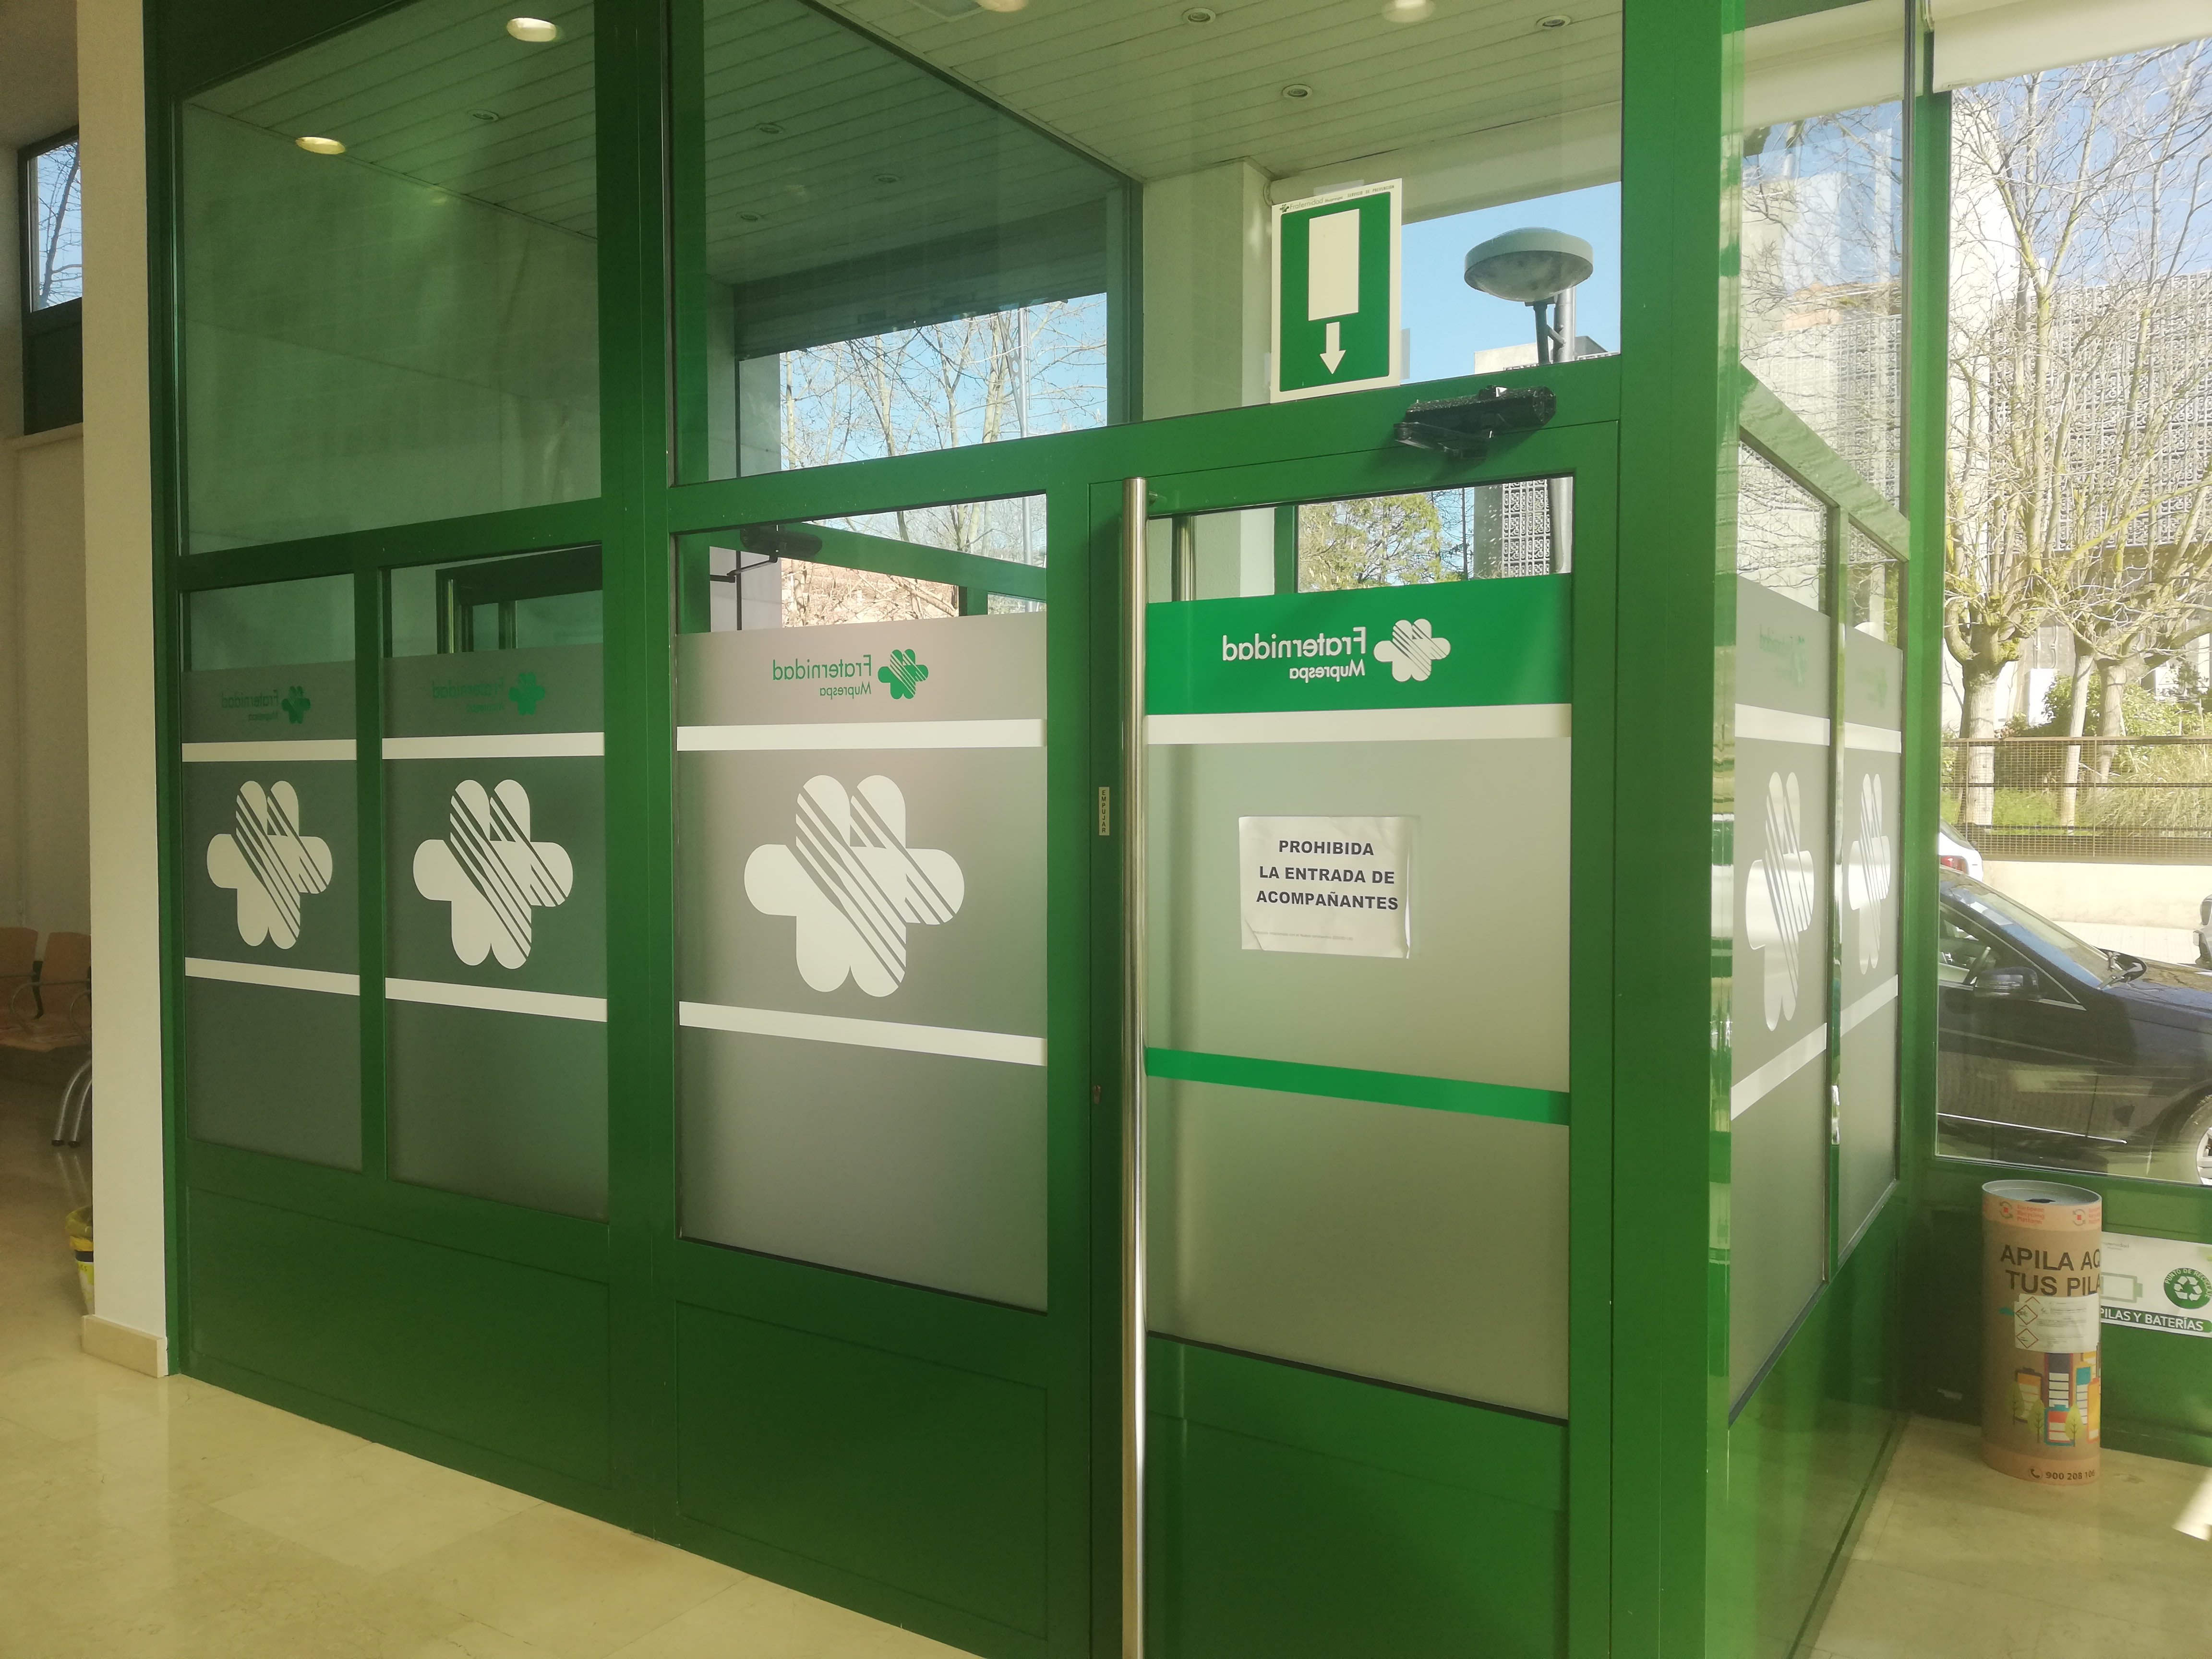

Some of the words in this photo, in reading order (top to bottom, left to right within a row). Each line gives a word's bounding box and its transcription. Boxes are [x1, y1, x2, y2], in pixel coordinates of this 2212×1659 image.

[1290, 197, 1323, 210] Fraternidad
[1278, 840, 1374, 856] PROHIBIDA
[1259, 866, 1279, 879] LA
[1285, 867, 1366, 883] ENTRADA
[1371, 870, 1395, 884] DE
[1256, 890, 1399, 911] ACOMPAÑANTES
[2000, 1244, 2074, 1271] APILA
[2005, 1269, 2057, 1296] TUS
[2164, 1269, 2181, 1285] PUNTO
[2133, 1312, 2142, 1322] Y
[2145, 1314, 2204, 1332] BATERÍAS
[2045, 1471, 2064, 1480] 900
[2067, 1472, 2082, 1480] 208
